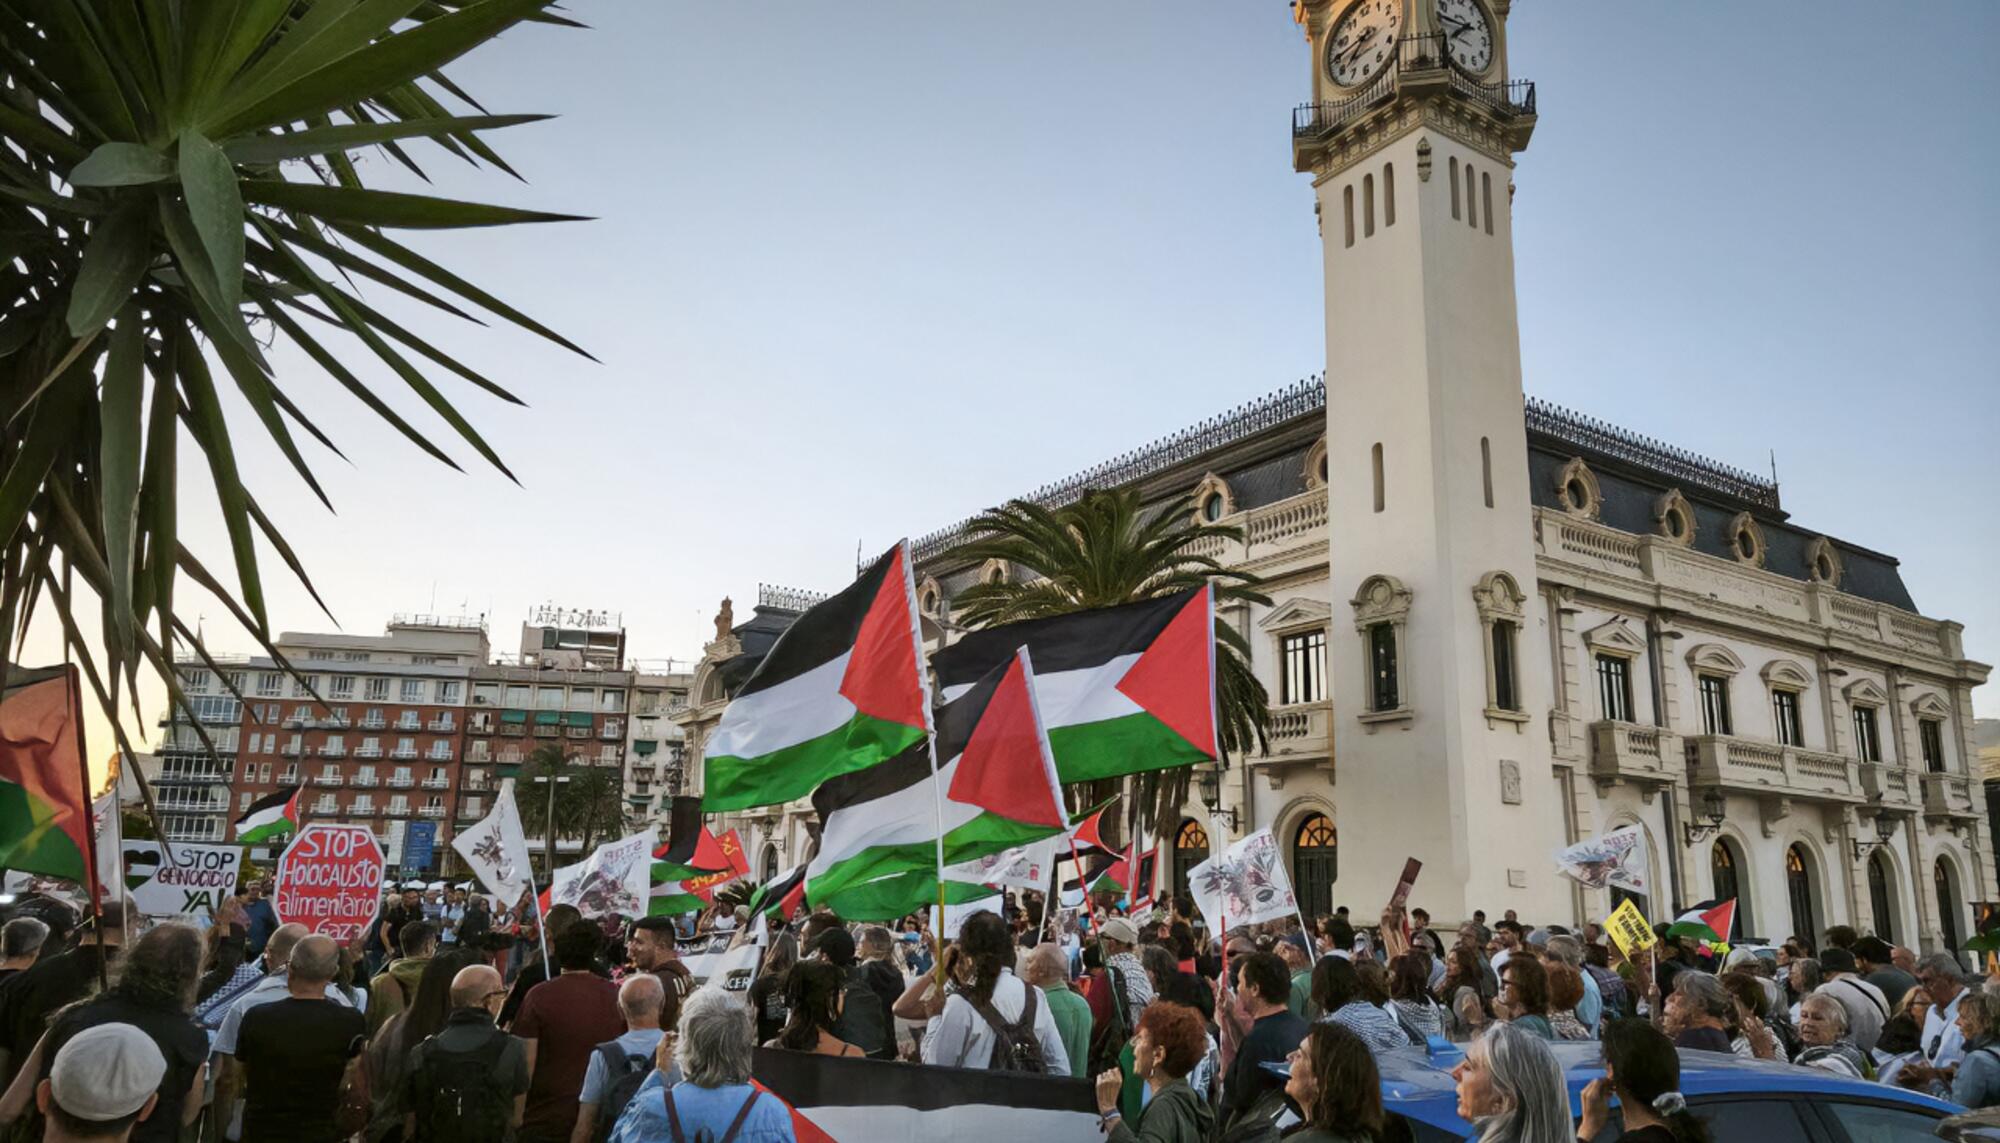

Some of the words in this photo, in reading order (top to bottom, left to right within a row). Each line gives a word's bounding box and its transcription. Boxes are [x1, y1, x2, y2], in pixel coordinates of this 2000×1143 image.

[298, 828, 370, 858] STOP
[175, 849, 236, 871] STOP
[157, 866, 236, 888] GENOCIDIO
[277, 886, 377, 917] alimentario
